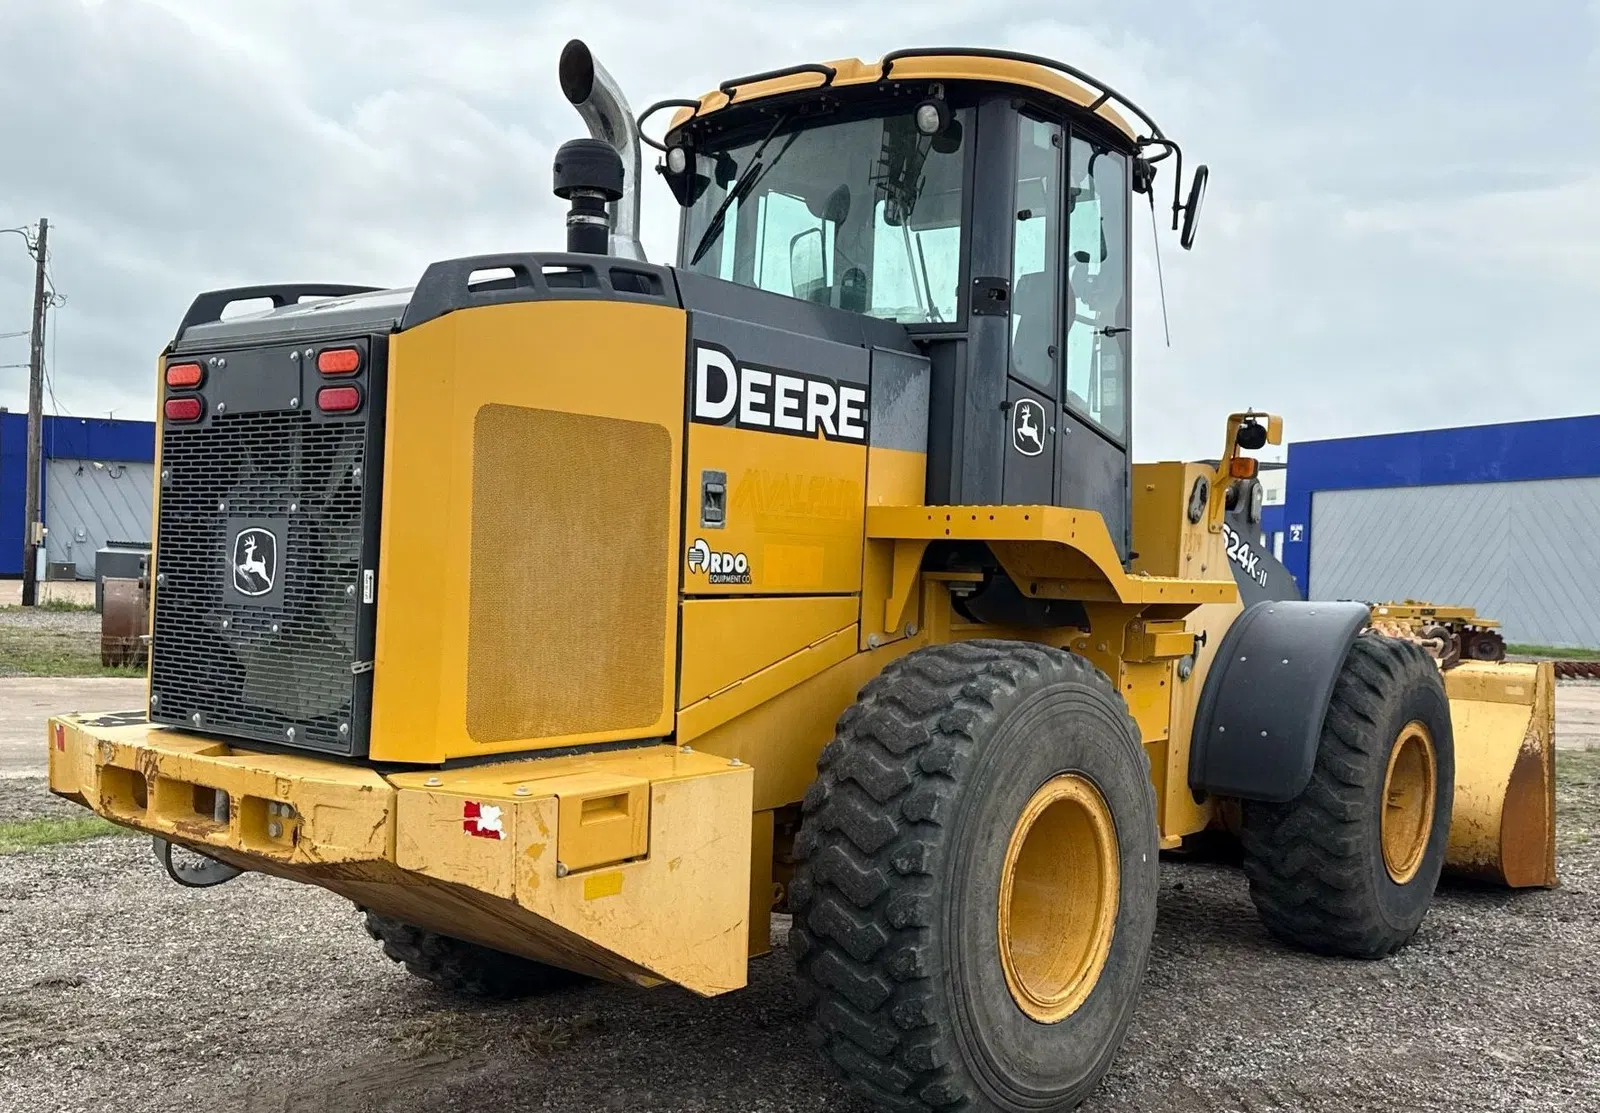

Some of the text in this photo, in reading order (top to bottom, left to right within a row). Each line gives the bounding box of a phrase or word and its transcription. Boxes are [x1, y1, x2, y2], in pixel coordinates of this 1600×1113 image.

[695, 347, 866, 440] DEERE
[1292, 530, 1300, 541] 2
[710, 553, 748, 574] RDO
[709, 574, 741, 583] EQUIPMENT
